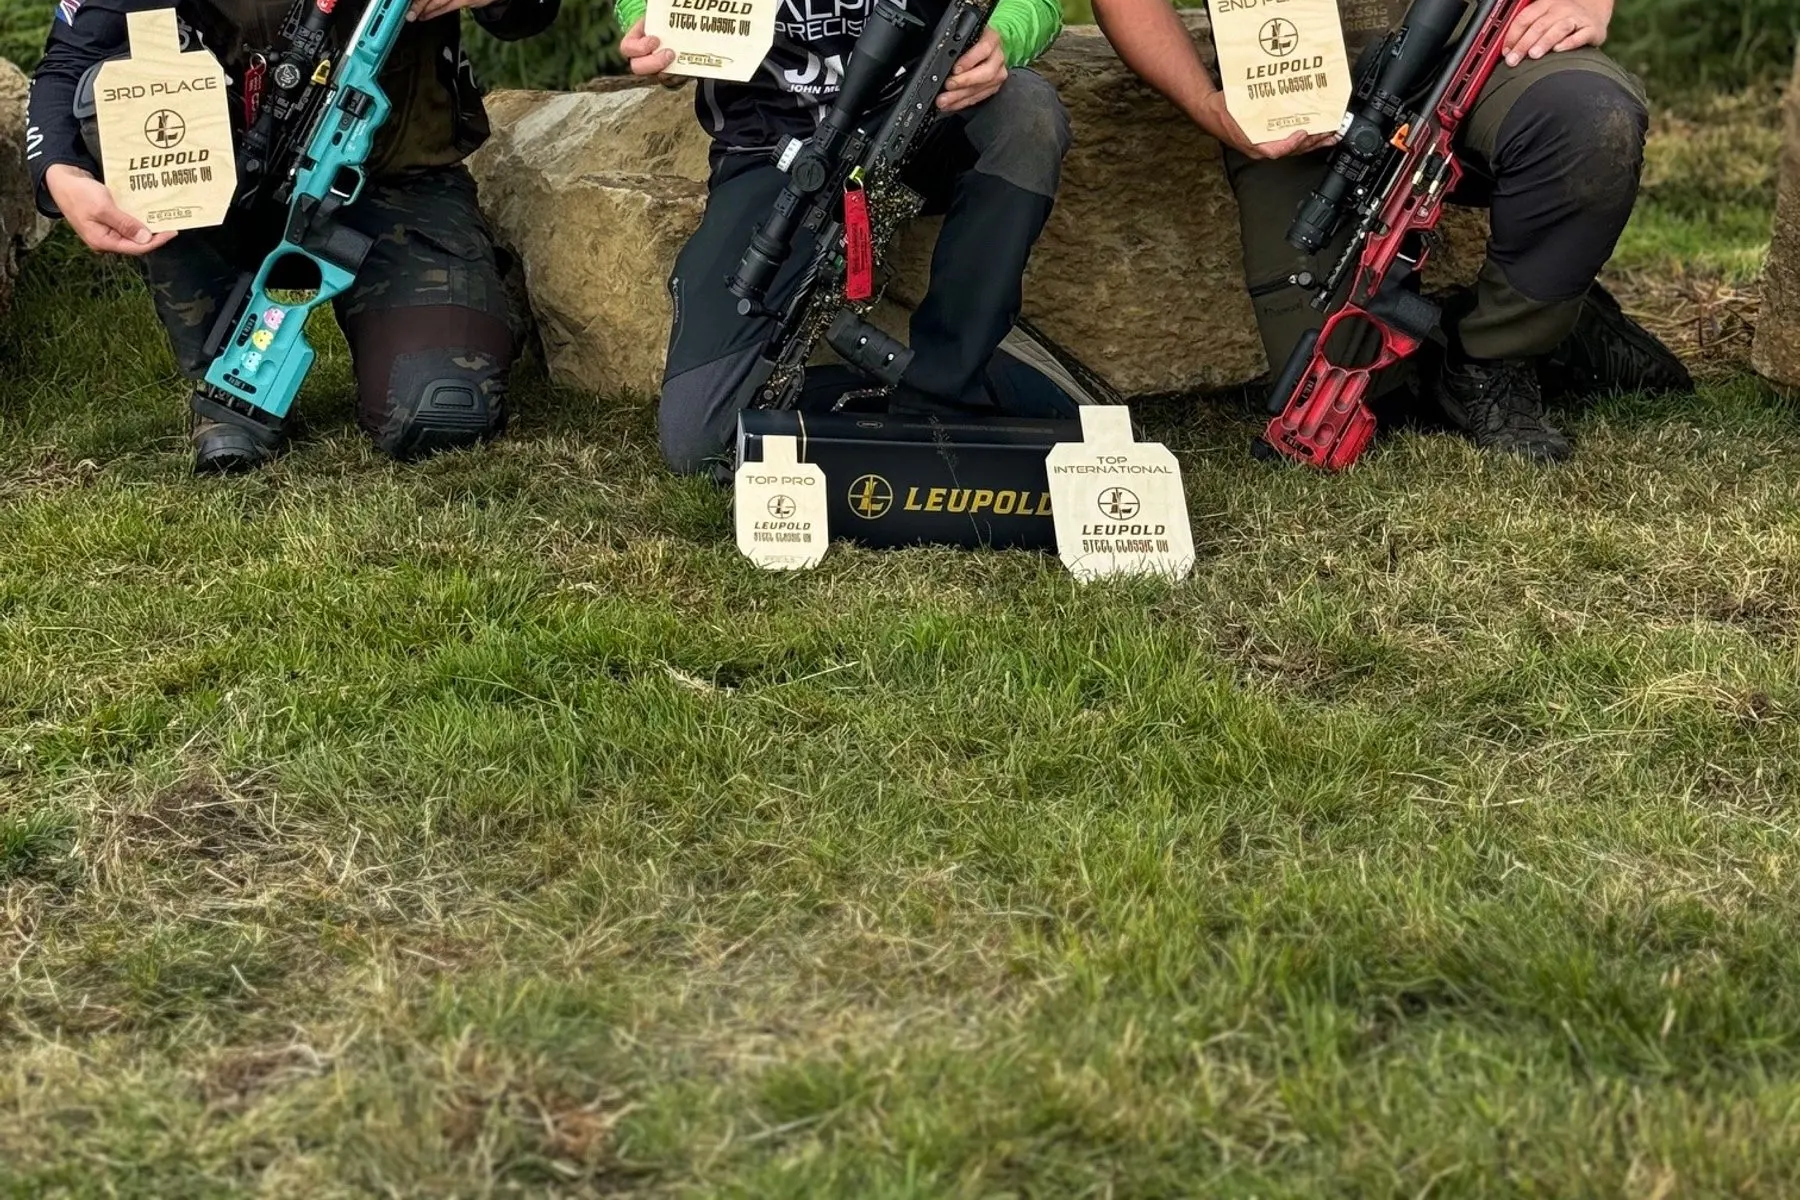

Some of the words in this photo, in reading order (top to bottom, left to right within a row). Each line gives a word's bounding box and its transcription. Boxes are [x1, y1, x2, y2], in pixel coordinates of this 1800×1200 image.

[669, 12, 697, 31] STEEL
[700, 15, 736, 35] CLASSIC
[1246, 55, 1323, 80] LEUPOLD
[104, 85, 145, 102] 3RD
[151, 76, 217, 96] PLACE
[787, 84, 822, 94] JOHN
[1247, 81, 1276, 100] STEEL
[1278, 75, 1313, 97] CLASSIC
[128, 149, 210, 170] LEUPOLD
[129, 172, 159, 191] STEEL
[161, 167, 198, 188] CLASSIC
[1096, 456, 1127, 464] TOP
[1054, 465, 1173, 474] INTERNATIONAL
[746, 475, 778, 485] TOP
[781, 476, 816, 486] PRO
[903, 486, 1054, 516] LEUPOLD
[754, 521, 811, 531] LEUPOLD
[1082, 524, 1166, 536] LEUPOLD
[1082, 539, 1113, 553] STEEL
[1115, 539, 1154, 553] CLASSIC
